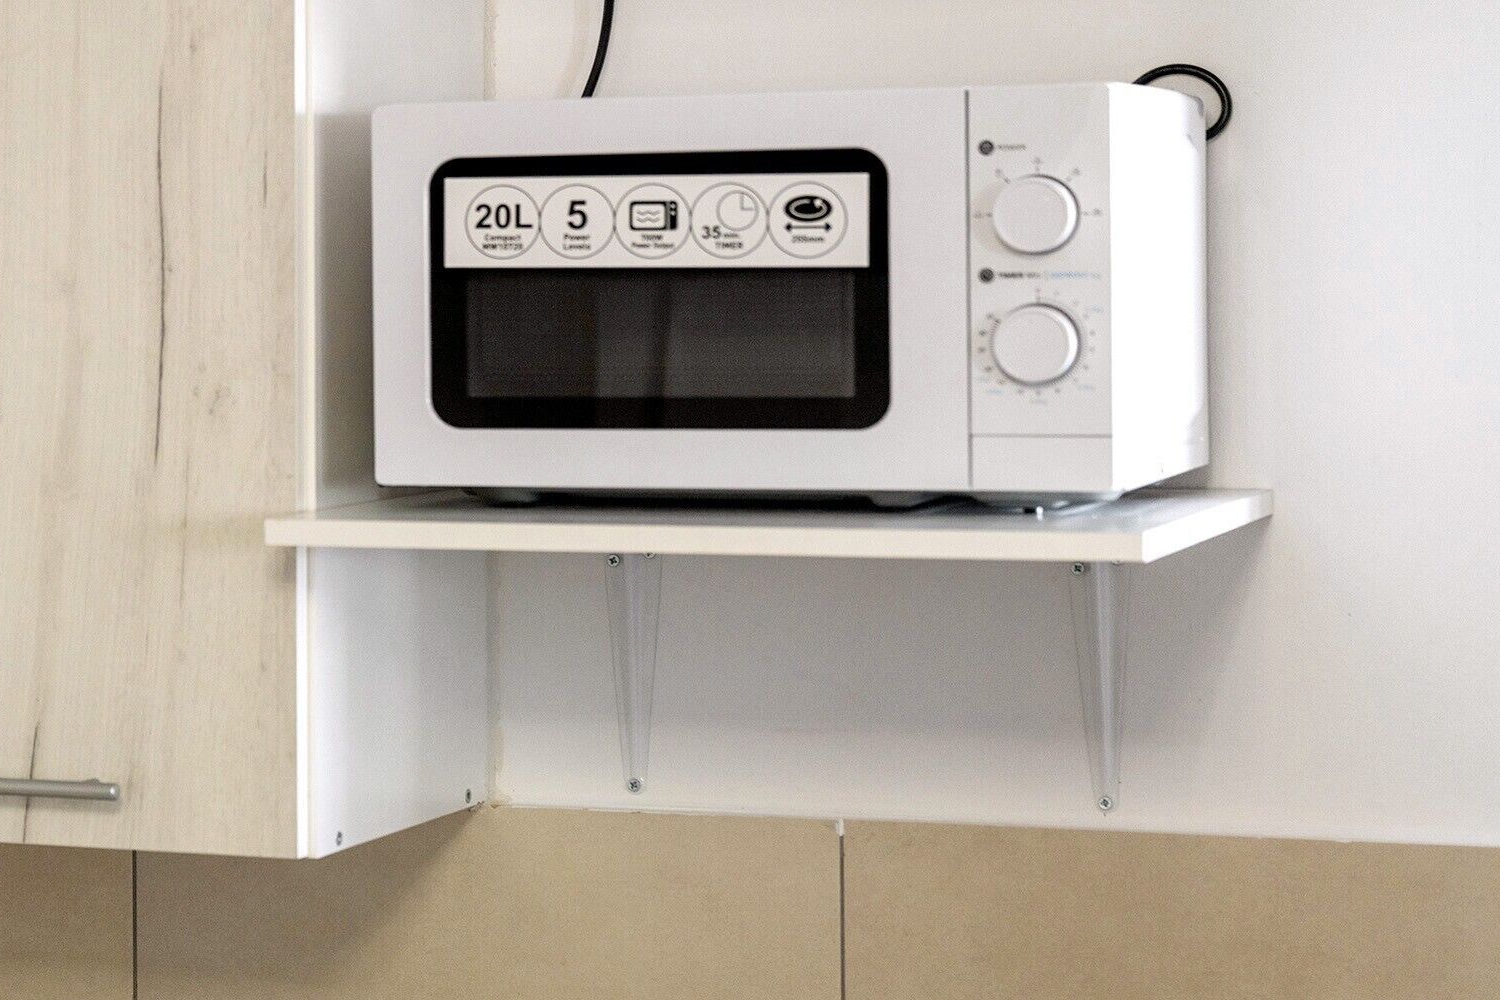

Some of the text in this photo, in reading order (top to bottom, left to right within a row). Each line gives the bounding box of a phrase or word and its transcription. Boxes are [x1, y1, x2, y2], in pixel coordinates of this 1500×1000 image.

[475, 203, 533, 229] 20L
[567, 199, 588, 230] 5
[702, 225, 721, 239] 35
